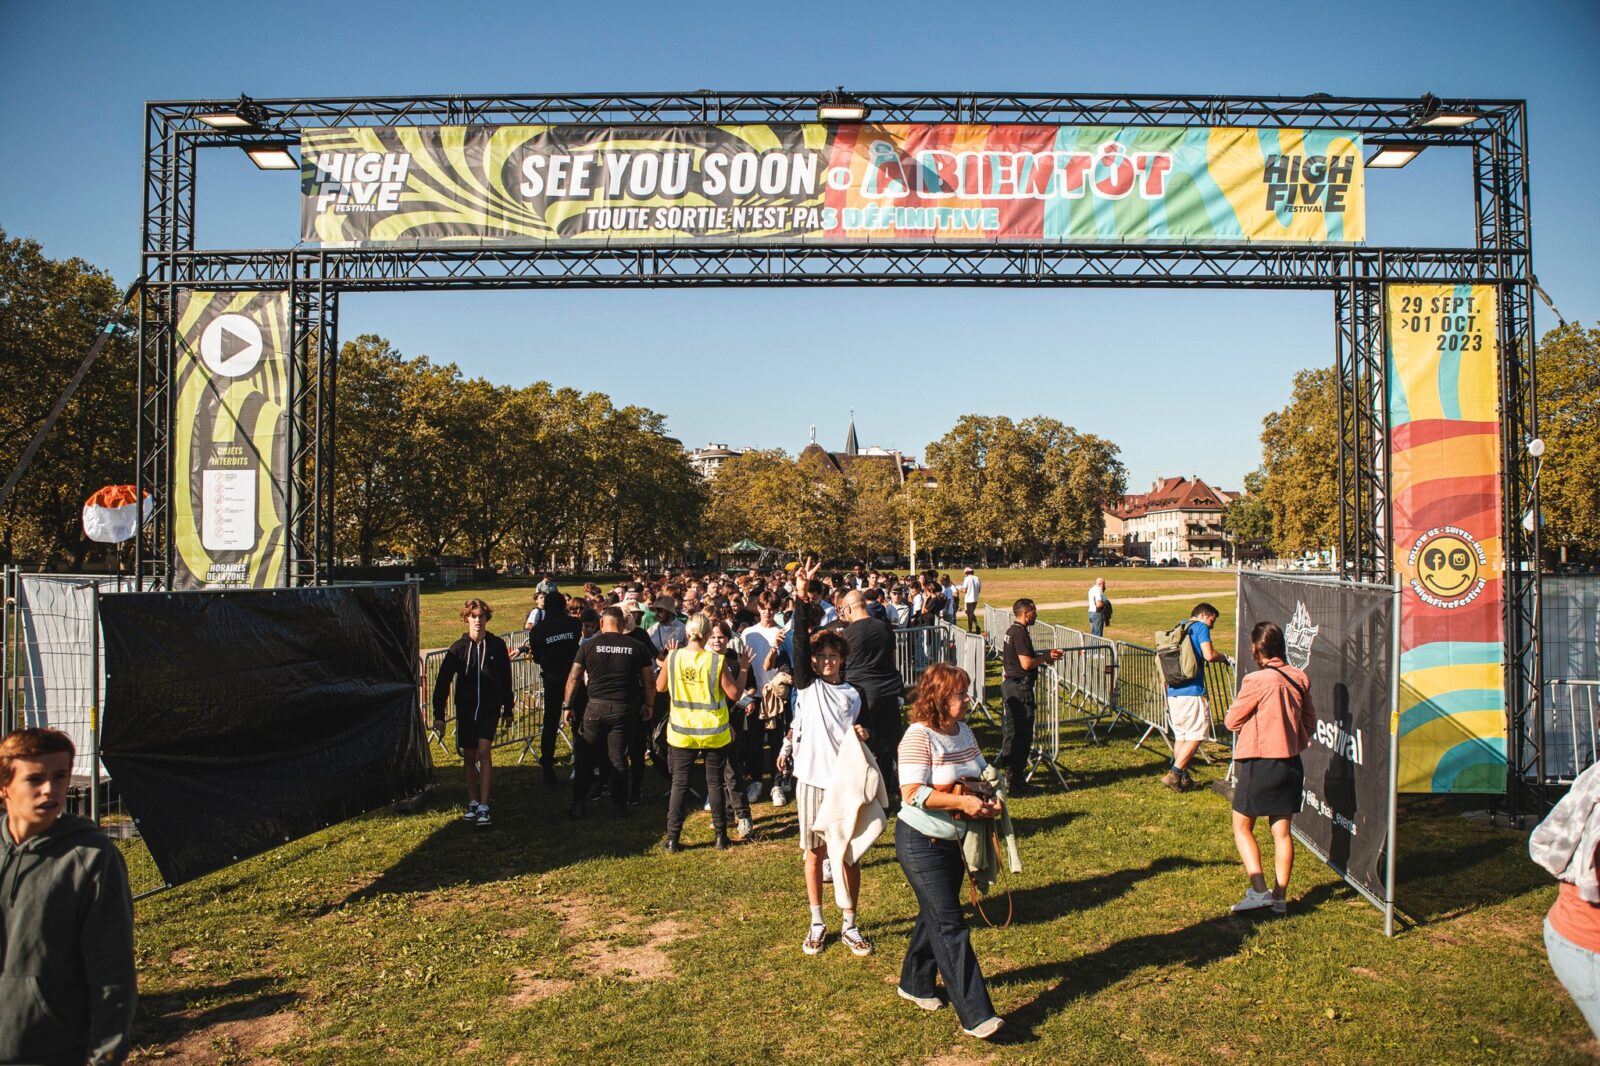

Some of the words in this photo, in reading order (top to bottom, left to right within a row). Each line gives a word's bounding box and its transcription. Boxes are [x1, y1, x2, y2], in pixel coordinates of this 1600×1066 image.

[316, 153, 410, 182] HIGH
[520, 154, 594, 198] SEE
[606, 153, 690, 196] YOU
[702, 152, 818, 195] SOON
[916, 141, 1173, 200] BIENTÔT
[1263, 155, 1354, 183] HIGH
[316, 182, 402, 212] FIVE
[1266, 184, 1348, 213] FIVE
[336, 204, 376, 212] FESTIVAL
[587, 208, 650, 230] TOUTE
[654, 207, 727, 229] SORTIE
[732, 207, 788, 229] N'EST
[793, 207, 838, 230] PAS
[842, 202, 1000, 230] DÉFINITIVE
[1284, 205, 1324, 213] FESTIVAL
[1401, 296, 1423, 313] 29
[1431, 296, 1480, 313] SEPT.
[1441, 315, 1481, 332] OCT.
[1436, 334, 1482, 351] 2023
[217, 447, 243, 455] OBJETS
[211, 457, 249, 466] INTERDITS
[1408, 533, 1428, 566] FOLLOW
[1428, 527, 1440, 537] US
[206, 572, 217, 580] DE
[210, 564, 246, 572] HORAIRES
[1410, 577, 1486, 609] @HighFiveFestival
[546, 632, 574, 644] SECURITE
[596, 645, 633, 654] SECURITE
[1313, 719, 1363, 765] estival
